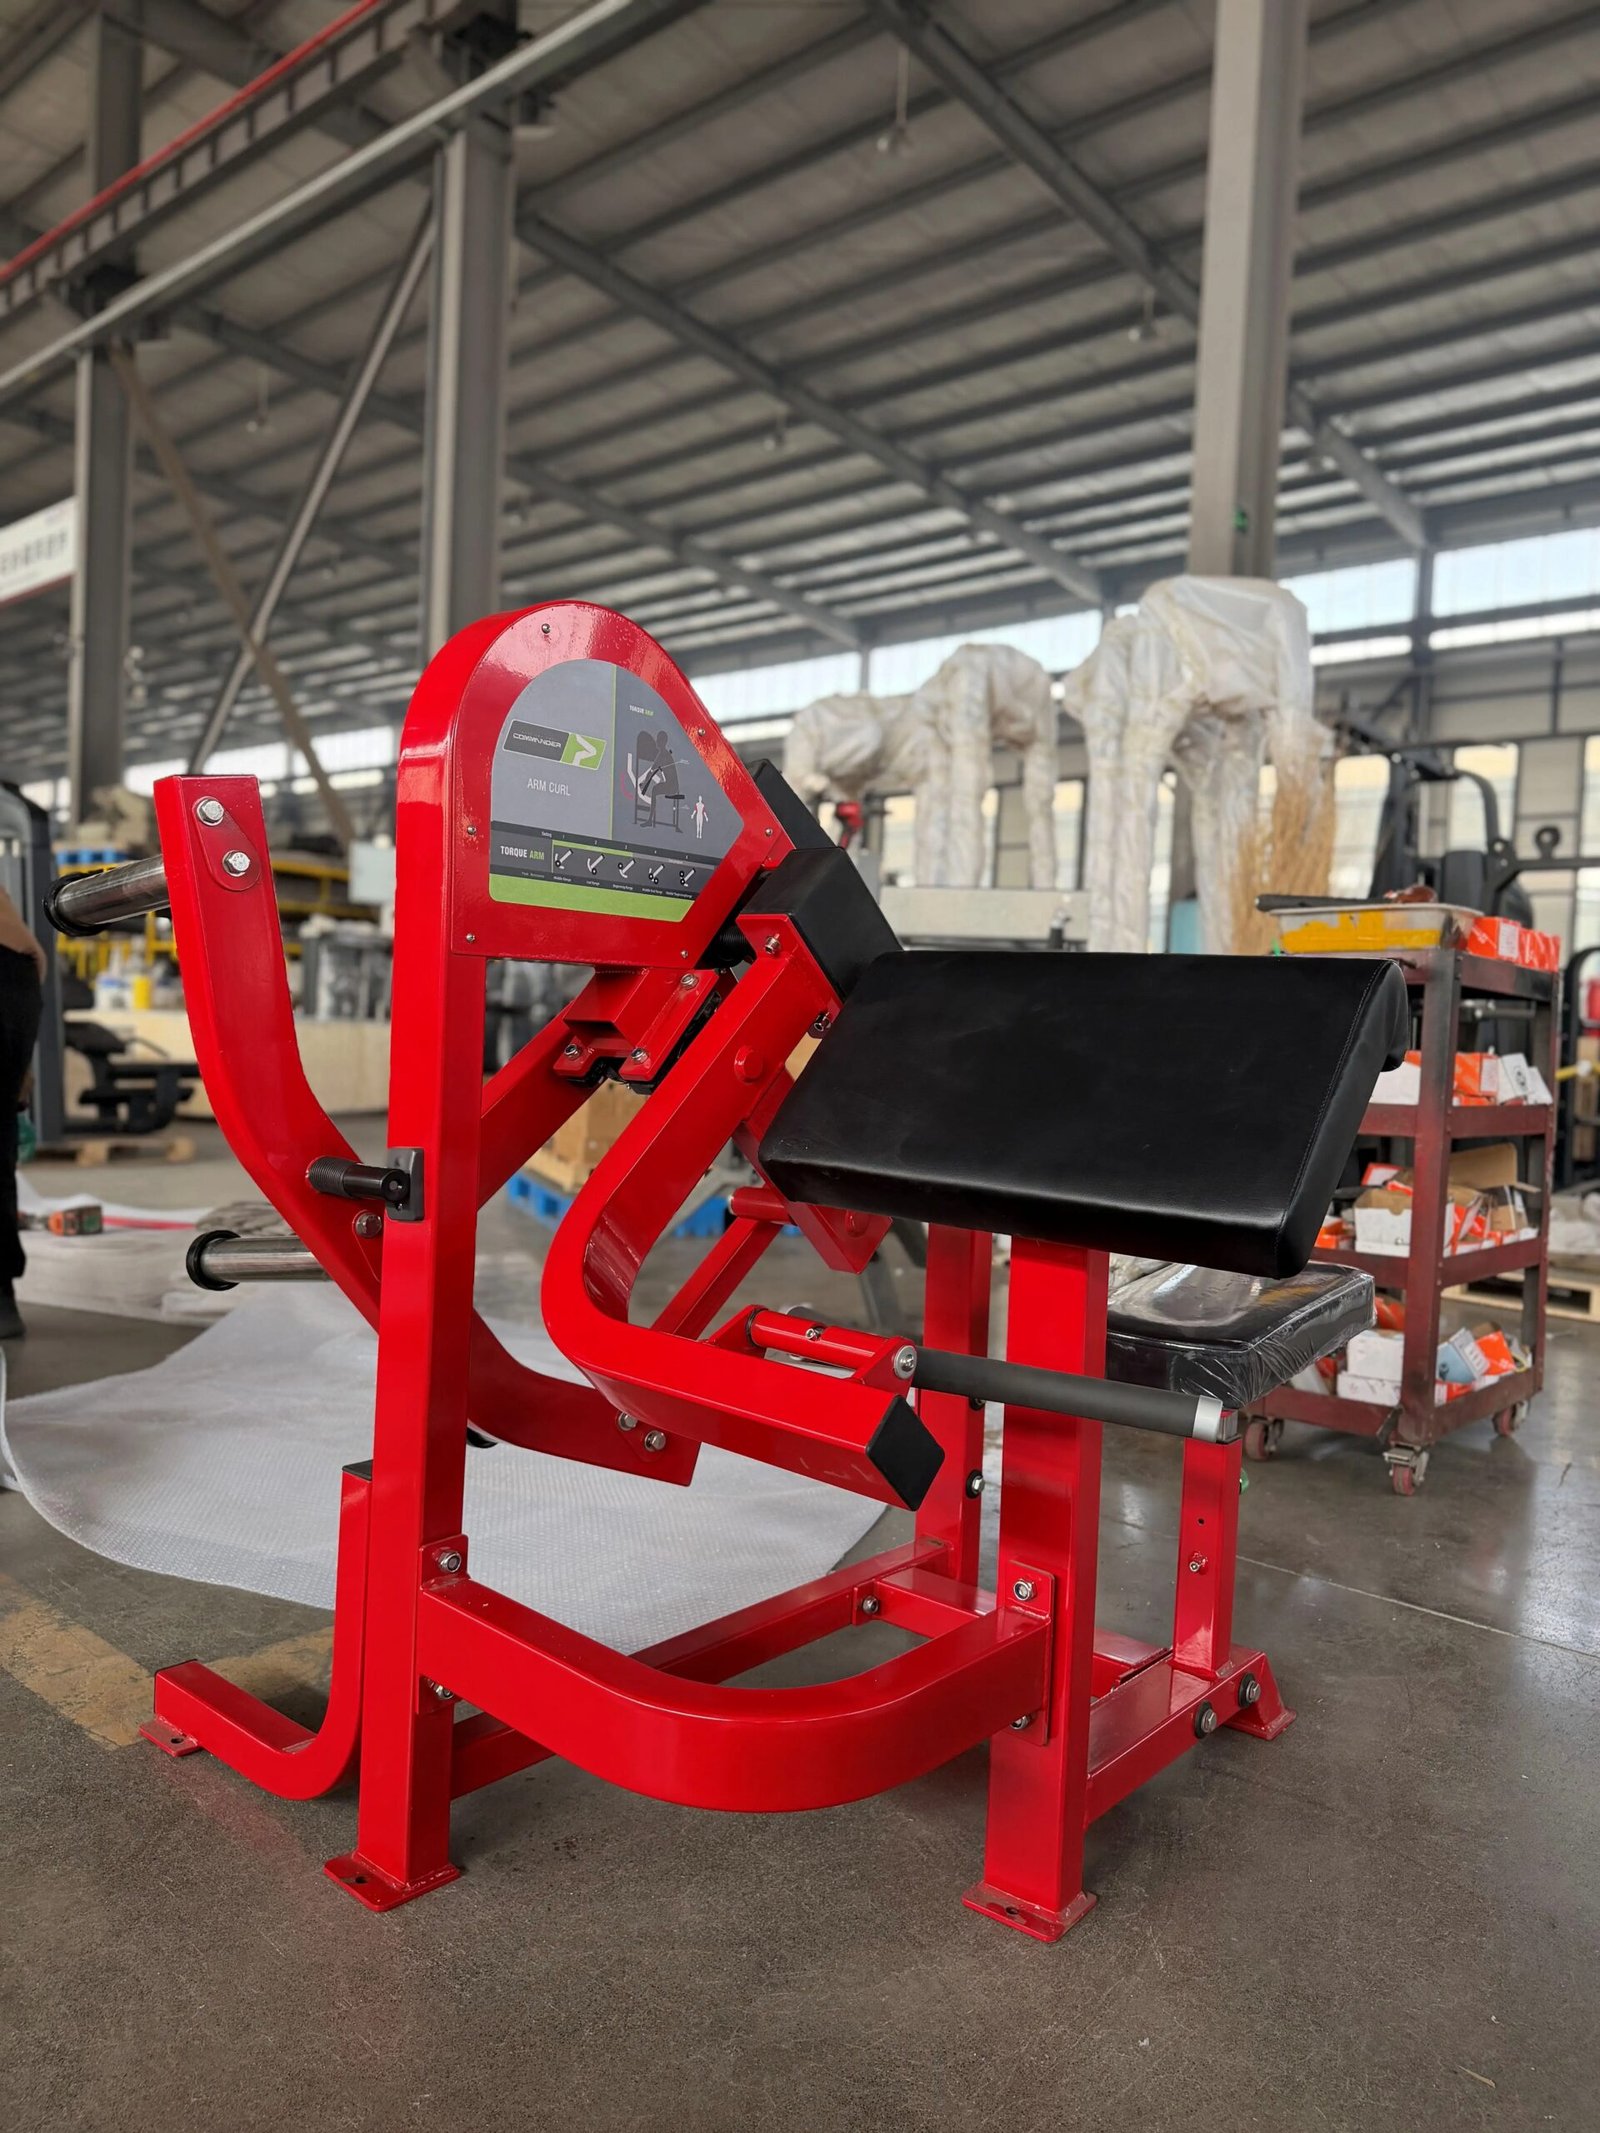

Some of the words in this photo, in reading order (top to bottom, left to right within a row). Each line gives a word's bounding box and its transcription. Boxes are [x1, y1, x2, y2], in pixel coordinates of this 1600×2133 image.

[527, 778, 547, 791] ARM
[549, 782, 571, 796] CURL
[500, 846, 527, 858] TORQUE
[529, 850, 545, 861] ARM
